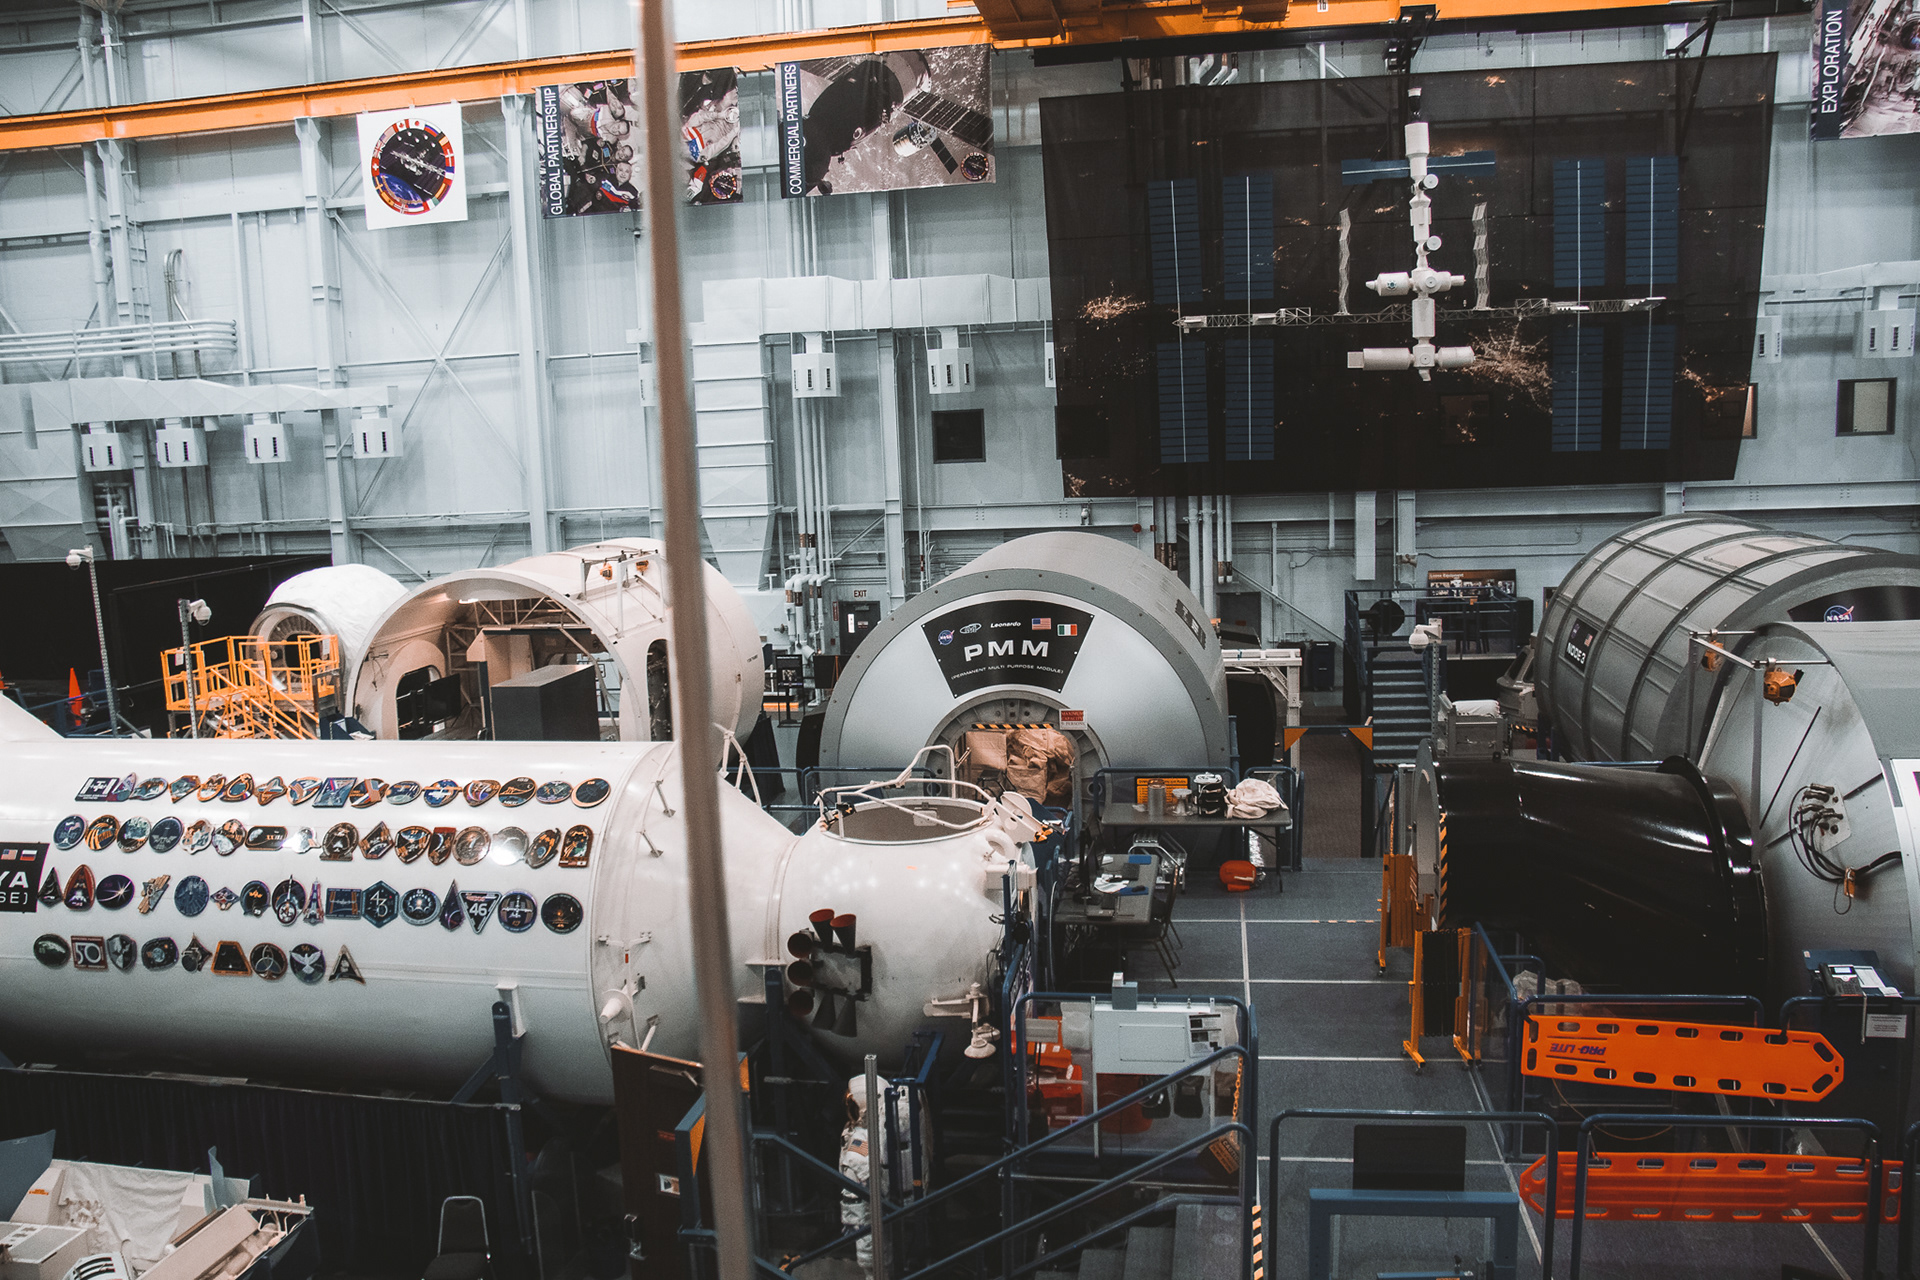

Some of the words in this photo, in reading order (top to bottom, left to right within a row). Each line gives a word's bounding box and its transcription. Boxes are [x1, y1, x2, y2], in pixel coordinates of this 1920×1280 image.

[1821, 9, 1843, 114] EXPLORATION
[784, 63, 798, 122] PARTNERS
[545, 87, 561, 167] PARTNERSHIP
[787, 121, 803, 195] COMMERCIAL
[549, 168, 564, 215] GLOBAL
[853, 590, 867, 598] EXIT
[990, 621, 1022, 629] Leonardo
[964, 639, 1049, 662] PMM
[1566, 642, 1582, 662] NODE
[469, 902, 488, 916] 46
[75, 942, 102, 965] 50
